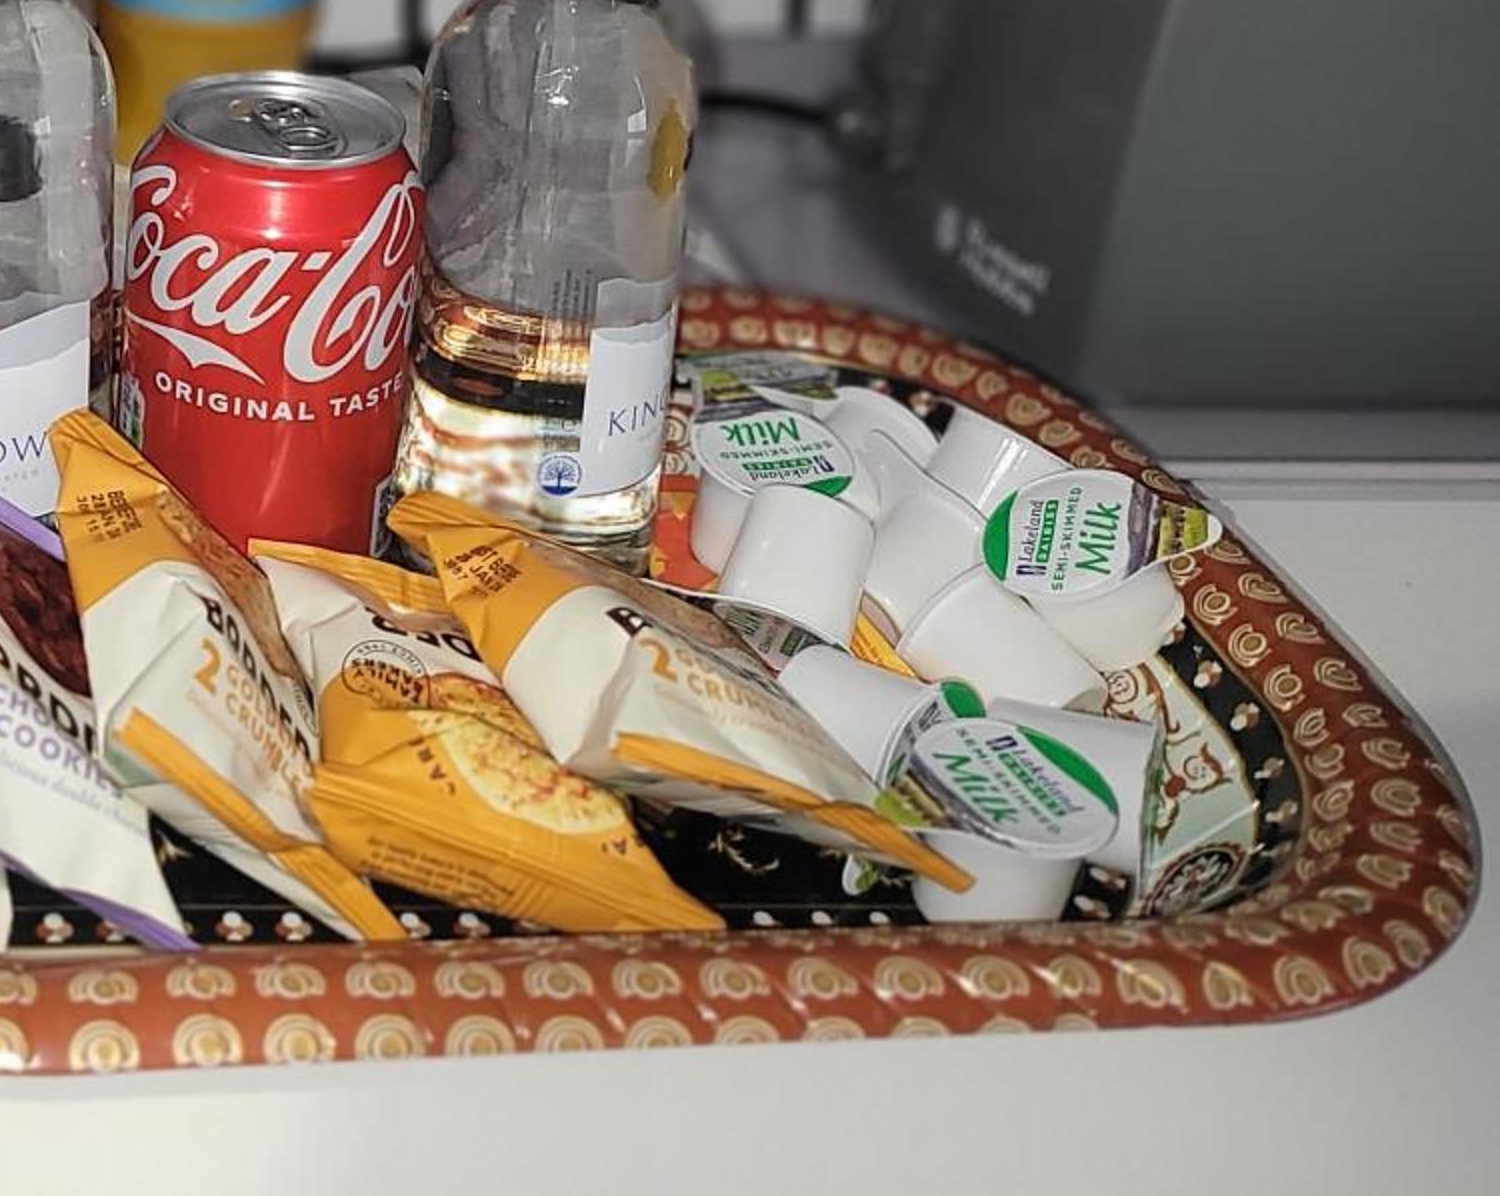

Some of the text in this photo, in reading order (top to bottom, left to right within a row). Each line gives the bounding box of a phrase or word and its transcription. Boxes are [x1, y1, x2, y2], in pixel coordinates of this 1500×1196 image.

[155, 371, 316, 422] ORIGINAL
[329, 370, 405, 417] TASTE
[720, 417, 802, 447] Milk
[1018, 499, 1044, 564] Lakeland
[1052, 487, 1083, 591] SEMI-SKIMMED
[1075, 500, 1122, 576] Milk
[196, 636, 222, 694] 2
[931, 752, 1020, 823] Milk
